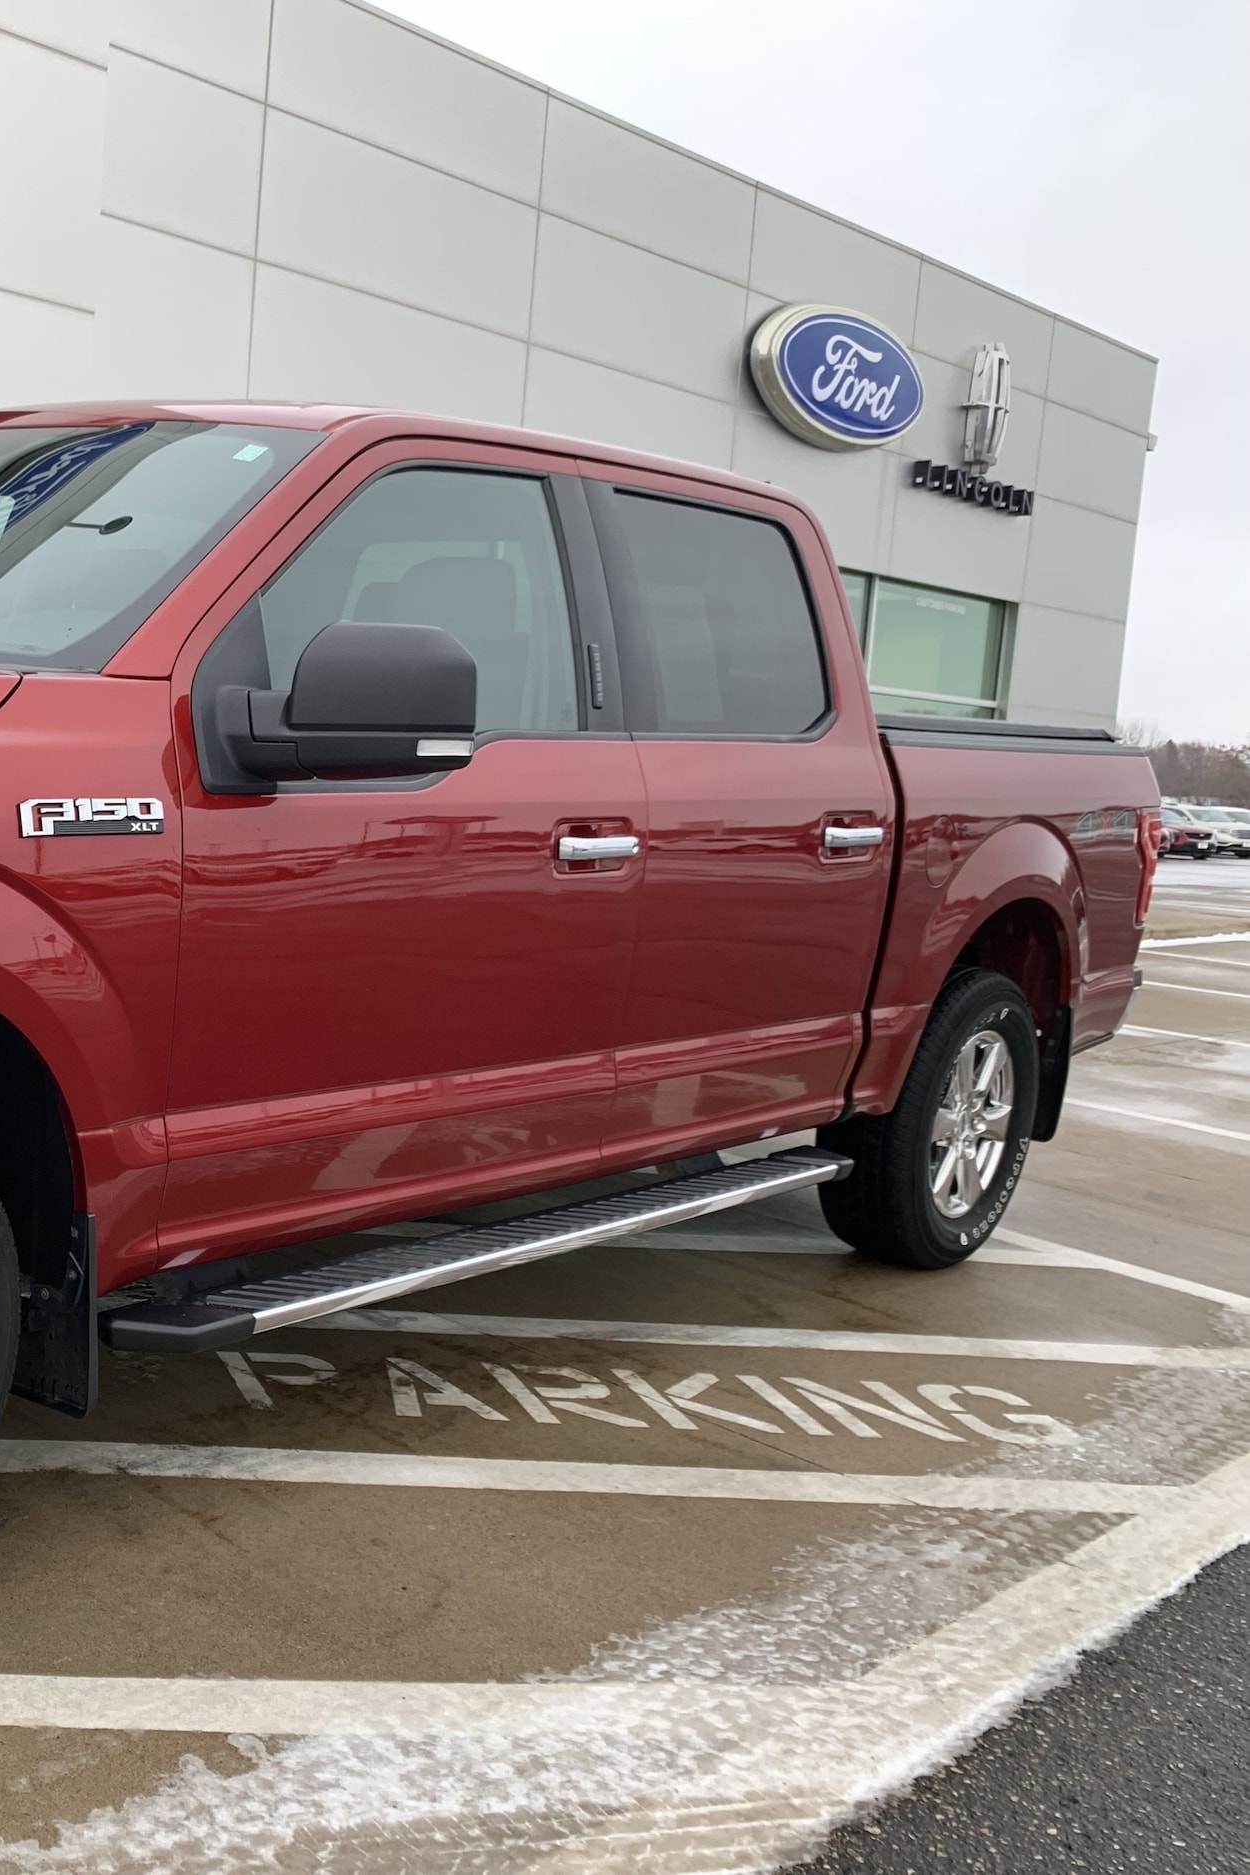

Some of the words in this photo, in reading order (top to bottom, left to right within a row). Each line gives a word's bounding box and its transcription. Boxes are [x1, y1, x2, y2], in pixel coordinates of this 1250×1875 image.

[812, 334, 900, 421] Ford
[913, 459, 1035, 516] LINCOLN
[131, 822, 159, 831] XLT
[216, 1350, 1080, 1446] PARKING
